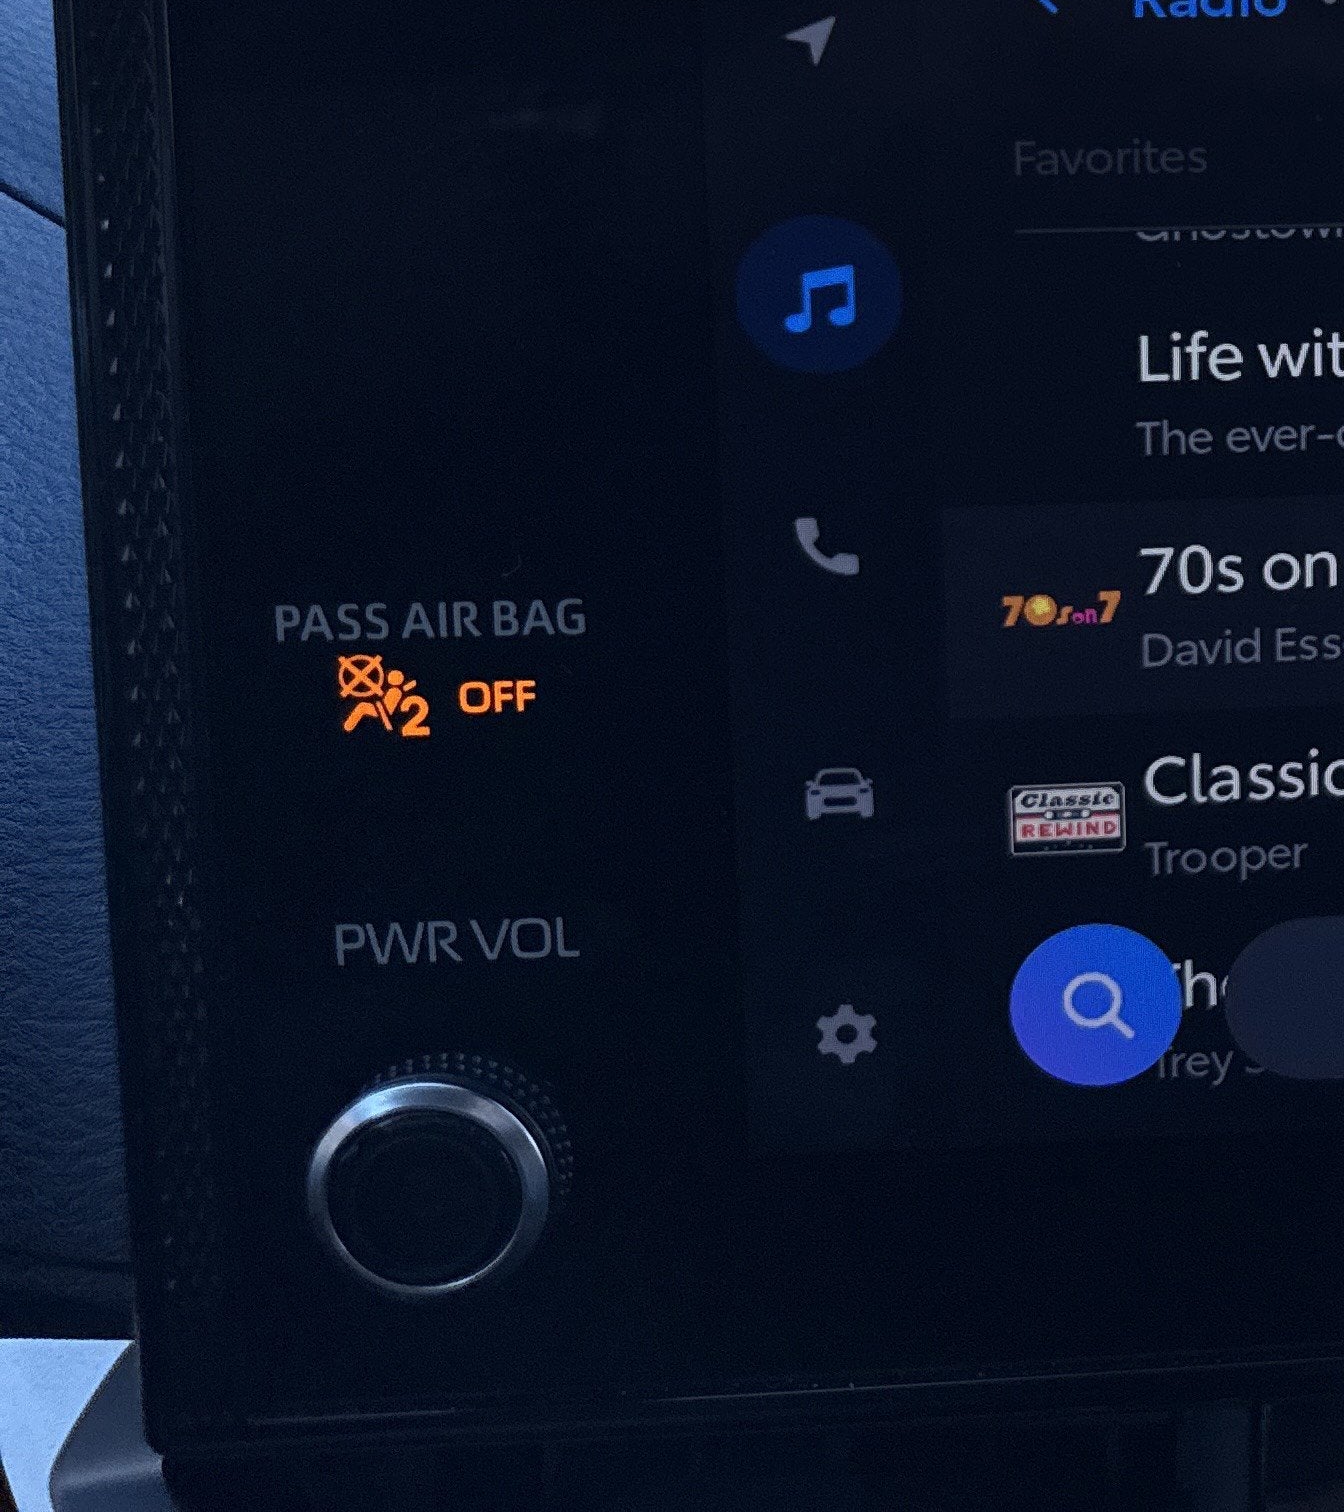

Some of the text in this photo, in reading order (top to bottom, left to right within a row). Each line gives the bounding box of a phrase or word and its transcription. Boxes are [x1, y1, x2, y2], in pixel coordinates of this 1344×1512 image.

[1013, 138, 1209, 177] Favorites
[1138, 329, 1243, 383] Life
[1137, 419, 1213, 456] The
[1138, 545, 1244, 596] 70s
[1263, 547, 1339, 593] on
[274, 598, 587, 642] PASS AIR BAG
[1141, 627, 1262, 668] David
[459, 680, 536, 714] OFF
[1021, 791, 1114, 808] Classic
[1021, 821, 1117, 838] REWIND
[1144, 838, 1309, 882] Trooper
[335, 916, 581, 966] PWR VOL
